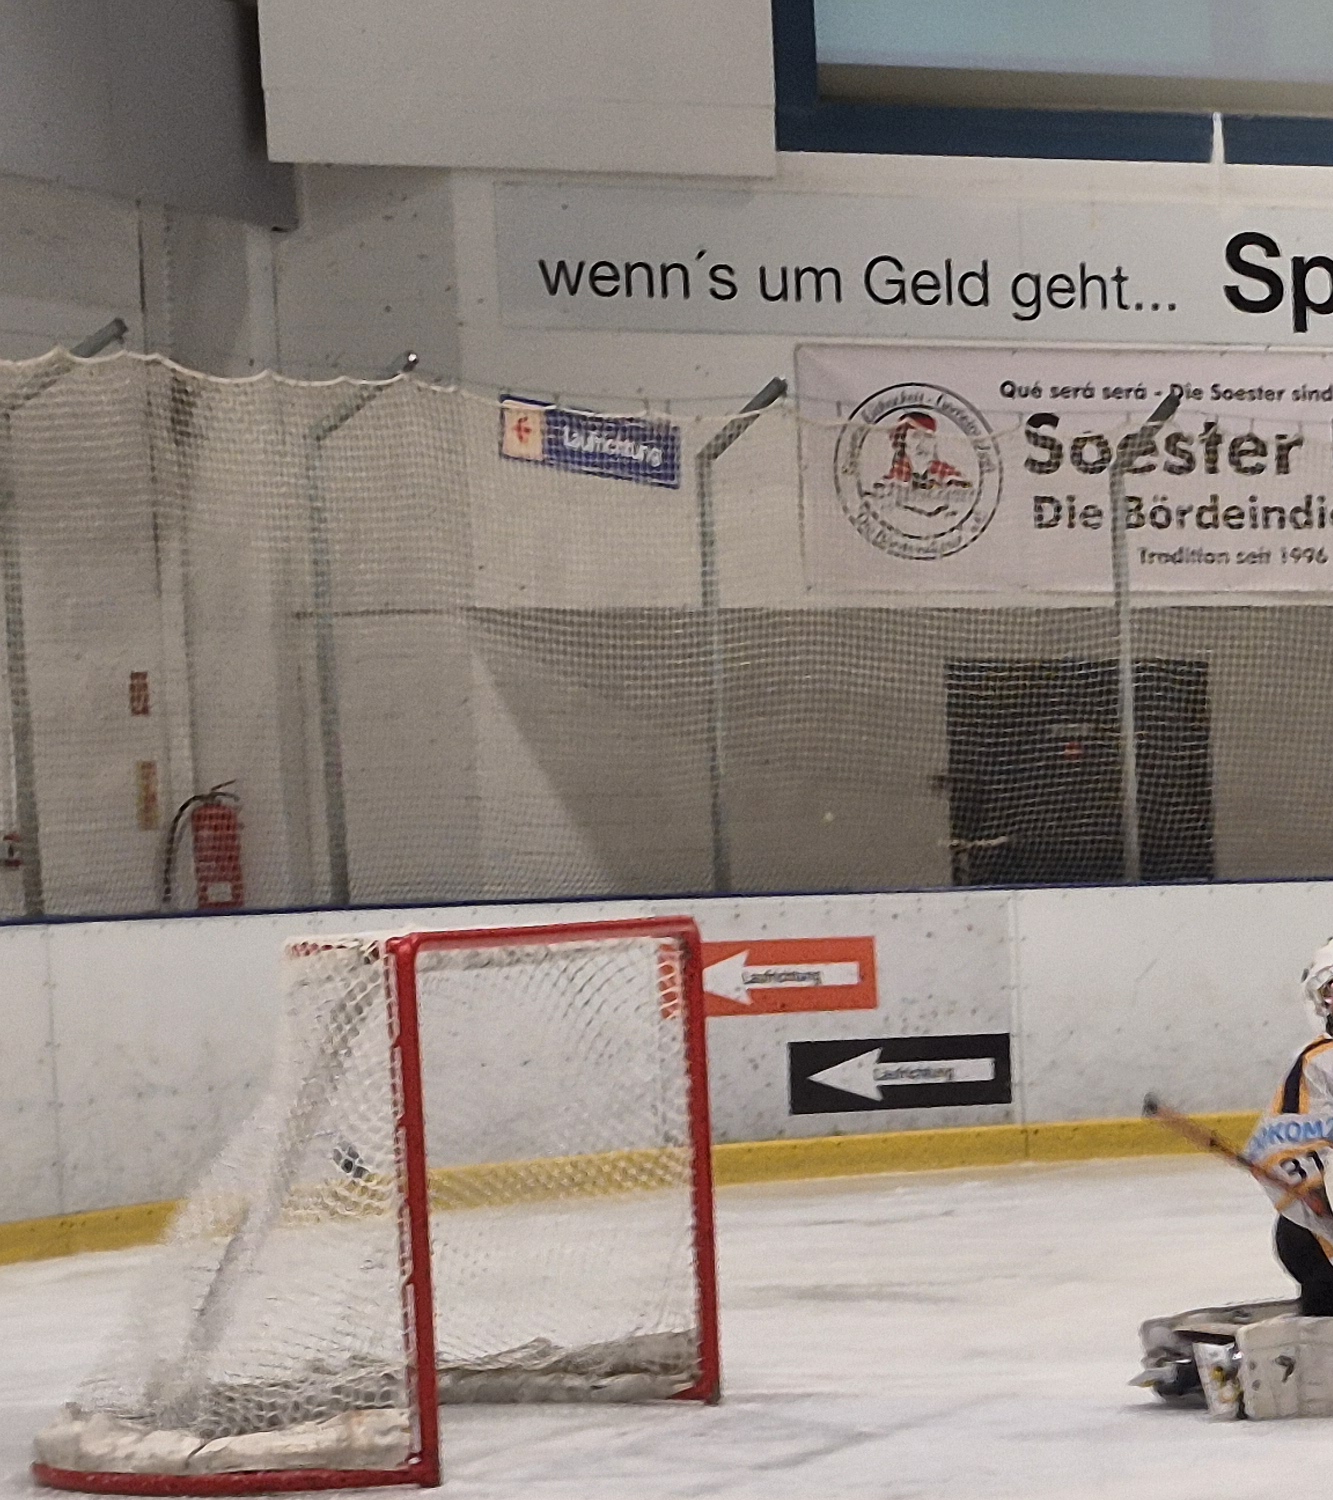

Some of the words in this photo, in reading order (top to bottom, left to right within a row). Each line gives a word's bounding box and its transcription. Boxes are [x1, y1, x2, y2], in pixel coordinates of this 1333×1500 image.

[758, 265, 842, 303] um
[863, 254, 989, 306] Geld
[1011, 261, 1177, 321] geht...
[1210, 383, 1286, 402] Soester
[1024, 412, 1304, 476] Soester
[1032, 495, 1104, 530] Die
